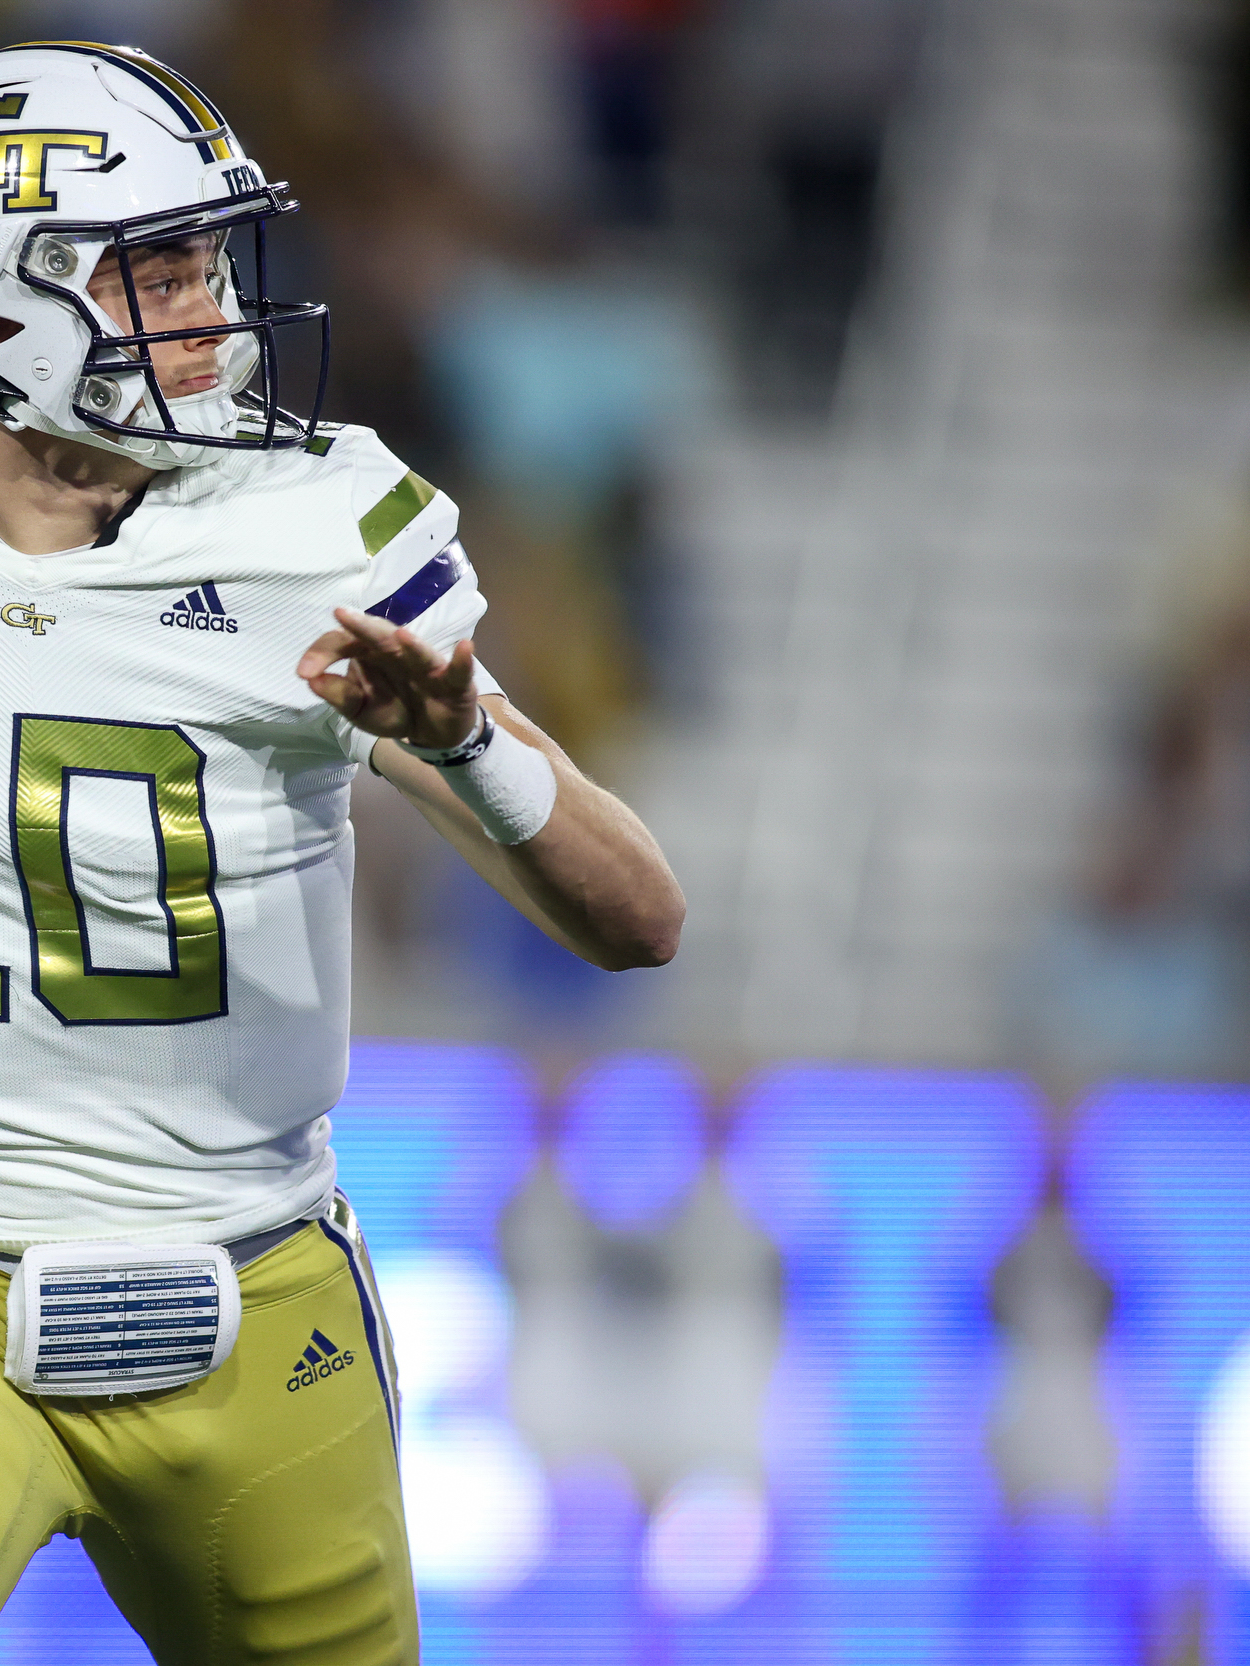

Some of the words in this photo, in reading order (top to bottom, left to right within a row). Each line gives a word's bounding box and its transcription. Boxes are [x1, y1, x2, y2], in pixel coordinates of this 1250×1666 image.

[0, 602, 57, 636] GT
[159, 609, 239, 635] adidas
[286, 1350, 355, 1393] adidas
